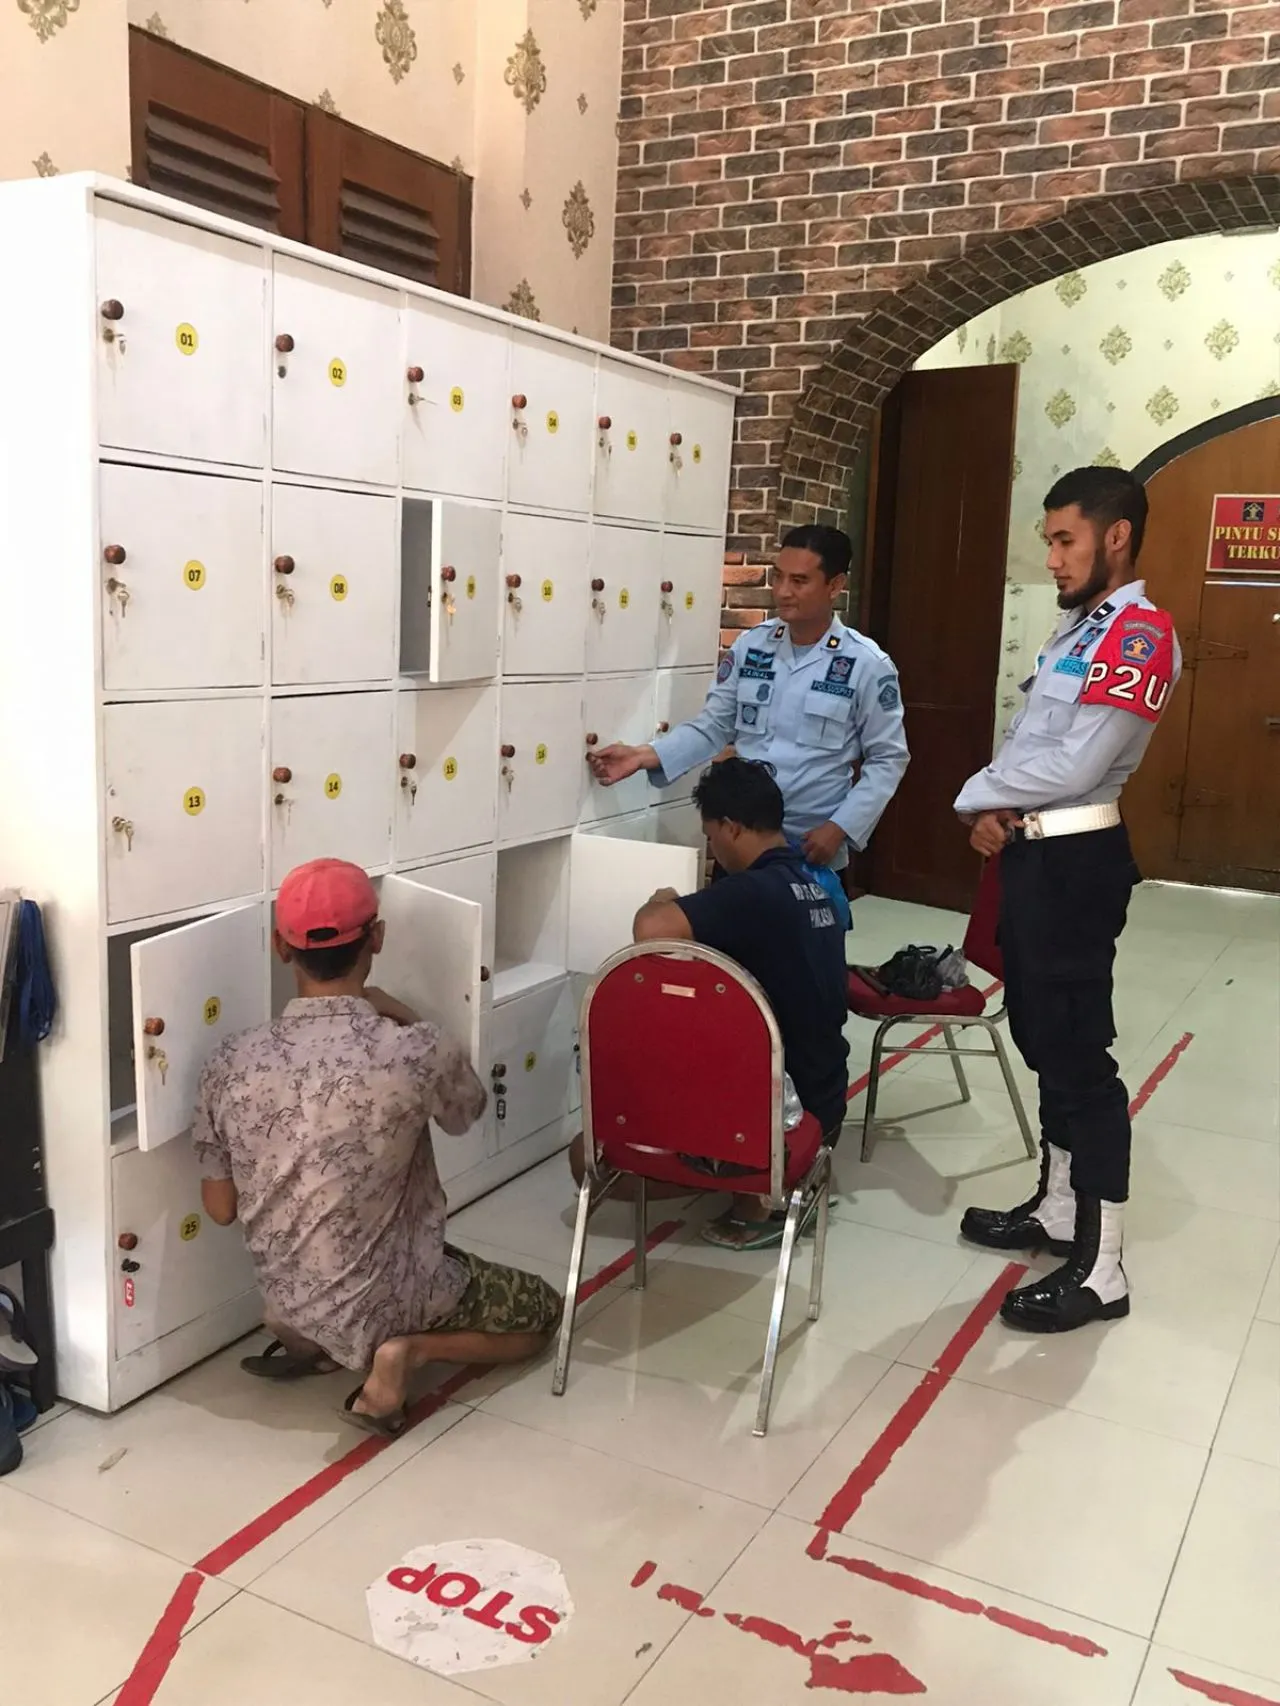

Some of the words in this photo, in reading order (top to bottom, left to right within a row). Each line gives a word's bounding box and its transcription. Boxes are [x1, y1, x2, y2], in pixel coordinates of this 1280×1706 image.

[180, 333, 193, 347] 01
[332, 367, 343, 380] 02
[453, 394, 461, 406] 03
[1215, 526, 1264, 540] PINTU
[188, 569, 201, 582] 07
[334, 582, 345, 594] 08
[1083, 662, 1168, 711] P2U
[446, 763, 454, 774] 15
[329, 781, 338, 792] 14
[189, 795, 201, 808] 13
[185, 1221, 197, 1235] 25
[387, 1562, 561, 1644] STOP
